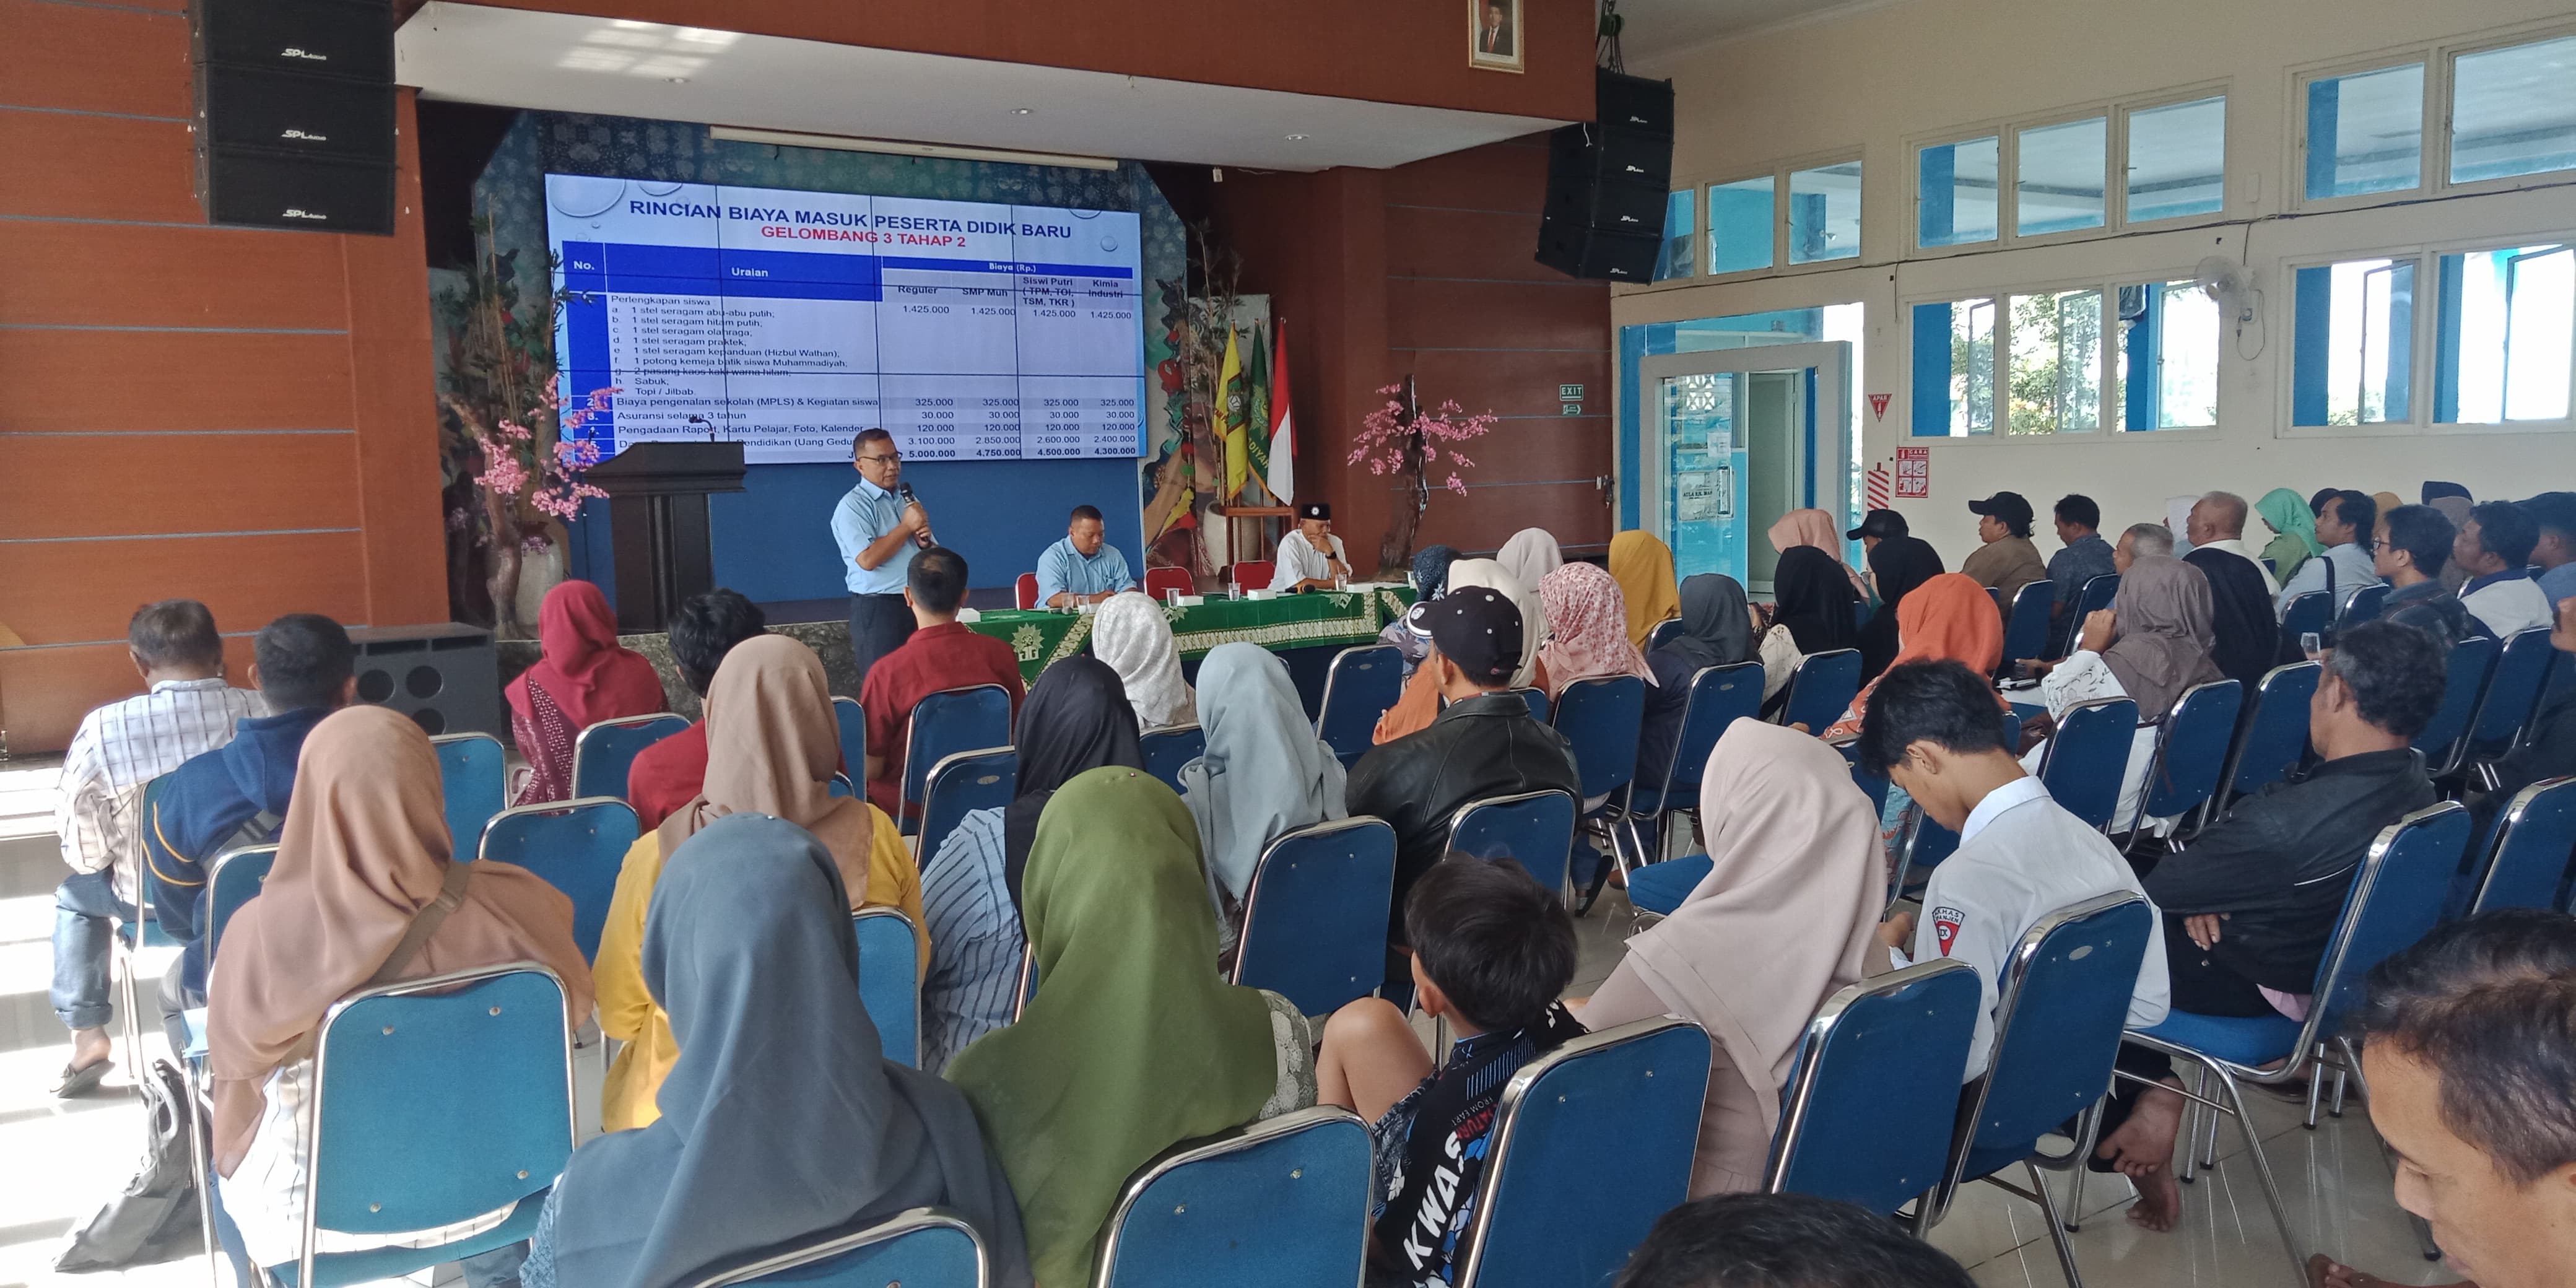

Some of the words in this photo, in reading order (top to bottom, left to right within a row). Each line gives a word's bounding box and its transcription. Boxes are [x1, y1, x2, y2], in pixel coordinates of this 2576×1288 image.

[629, 200, 721, 219] RINCIAN
[729, 206, 790, 223] BIAYA
[795, 210, 868, 227] MASUK
[875, 215, 962, 233] PESERTA
[967, 220, 1016, 236] DIDIK
[1022, 224, 1071, 238] BARU
[761, 225, 878, 243] GELOMBANG
[883, 233, 892, 244] 3
[897, 233, 953, 247] TAHAP
[957, 237, 966, 247] 2
[573, 260, 595, 270] No.
[989, 263, 1014, 272] Biaya
[1016, 264, 1037, 273] (Rp.)
[731, 266, 768, 277] Uraian
[1022, 277, 1048, 285] Siswi
[1051, 277, 1073, 286] Putri
[1092, 279, 1118, 288] Kimia
[898, 285, 938, 295] Reguler
[962, 288, 985, 296] SMP
[987, 289, 1008, 297] Muh
[1089, 289, 1123, 298] Industri
[611, 295, 681, 305] Perlengkapan
[1023, 297, 1046, 306] TSM,
[1048, 298, 1069, 306] TKR
[661, 308, 703, 316] seragam
[707, 308, 746, 316] abu-abu
[749, 310, 775, 318] putih;
[903, 305, 950, 313] 1.425.000
[972, 307, 1016, 316] 1.425.000
[1033, 310, 1076, 318] 1.425.000
[1090, 311, 1131, 320] 1.425.000
[661, 318, 704, 326] seragam
[737, 320, 763, 328] putih;
[707, 329, 752, 337] olahraga;
[708, 348, 762, 357] kepanduan
[764, 349, 796, 357] (Hizbul
[643, 358, 677, 366] potong
[681, 358, 715, 366] kemeja
[773, 359, 848, 368] Muhammadiyah;
[635, 388, 656, 396] Topi
[1561, 387, 1582, 395] EXIT
[617, 398, 645, 407] Biaya
[650, 398, 711, 407] pengenalan
[757, 398, 794, 407] (MPLS)
[807, 398, 849, 407] Kegiatan
[915, 398, 953, 406] 325.000
[983, 398, 1019, 406] 325.000
[617, 412, 664, 420] Asuransi
[619, 426, 679, 435] Pengadaan
[682, 426, 720, 434] Rapot,
[754, 425, 791, 434] Pelajar,
[794, 425, 818, 433] Foto,
[794, 438, 824, 447] (Uang
[909, 450, 955, 458] 5.000.000
[1094, 447, 1136, 455] 4.300.000
[1470, 1096, 1493, 1113] FROM
